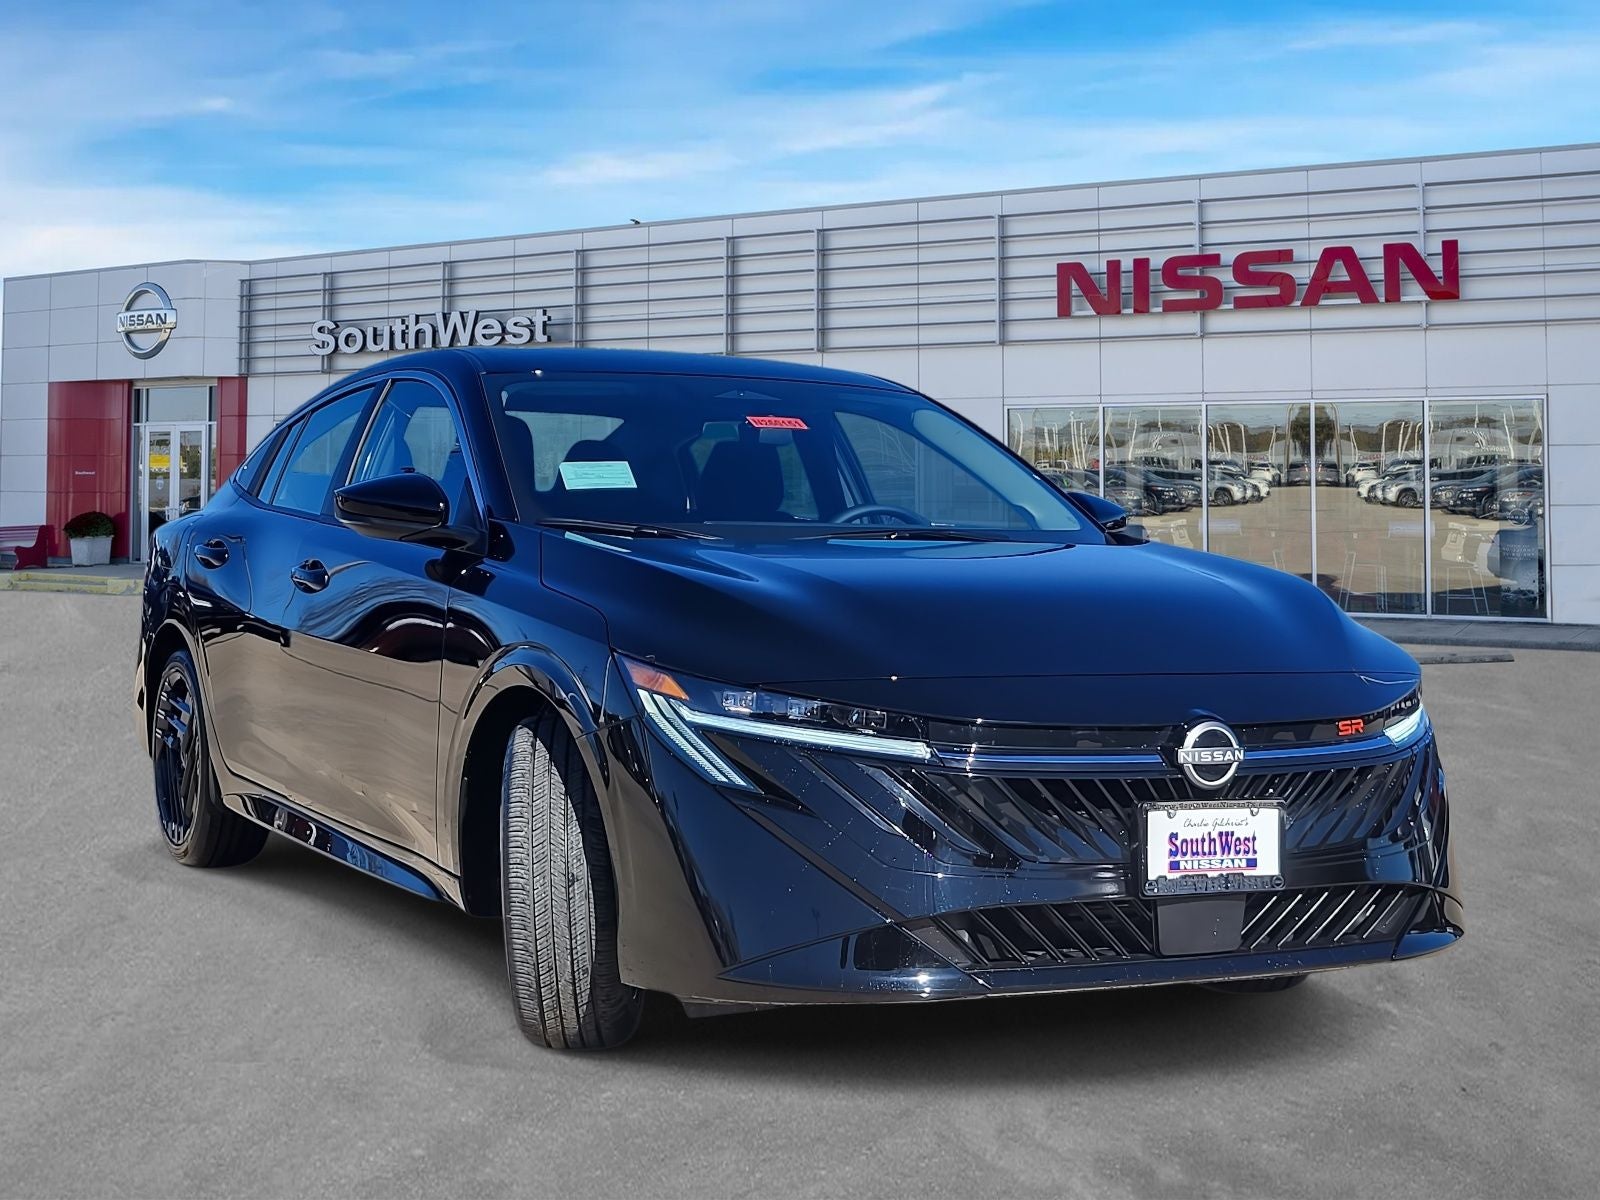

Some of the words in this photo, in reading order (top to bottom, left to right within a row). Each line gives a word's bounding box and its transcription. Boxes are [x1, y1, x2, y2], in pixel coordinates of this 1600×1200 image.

[1056, 239, 1462, 318] NISSAN
[118, 313, 168, 328] NISSAN
[309, 308, 551, 356] SouthWest
[1337, 719, 1364, 736] SR
[1180, 749, 1245, 763] NISSAN
[1168, 831, 1258, 858] SouthWest
[1179, 858, 1247, 870] NISSAN
